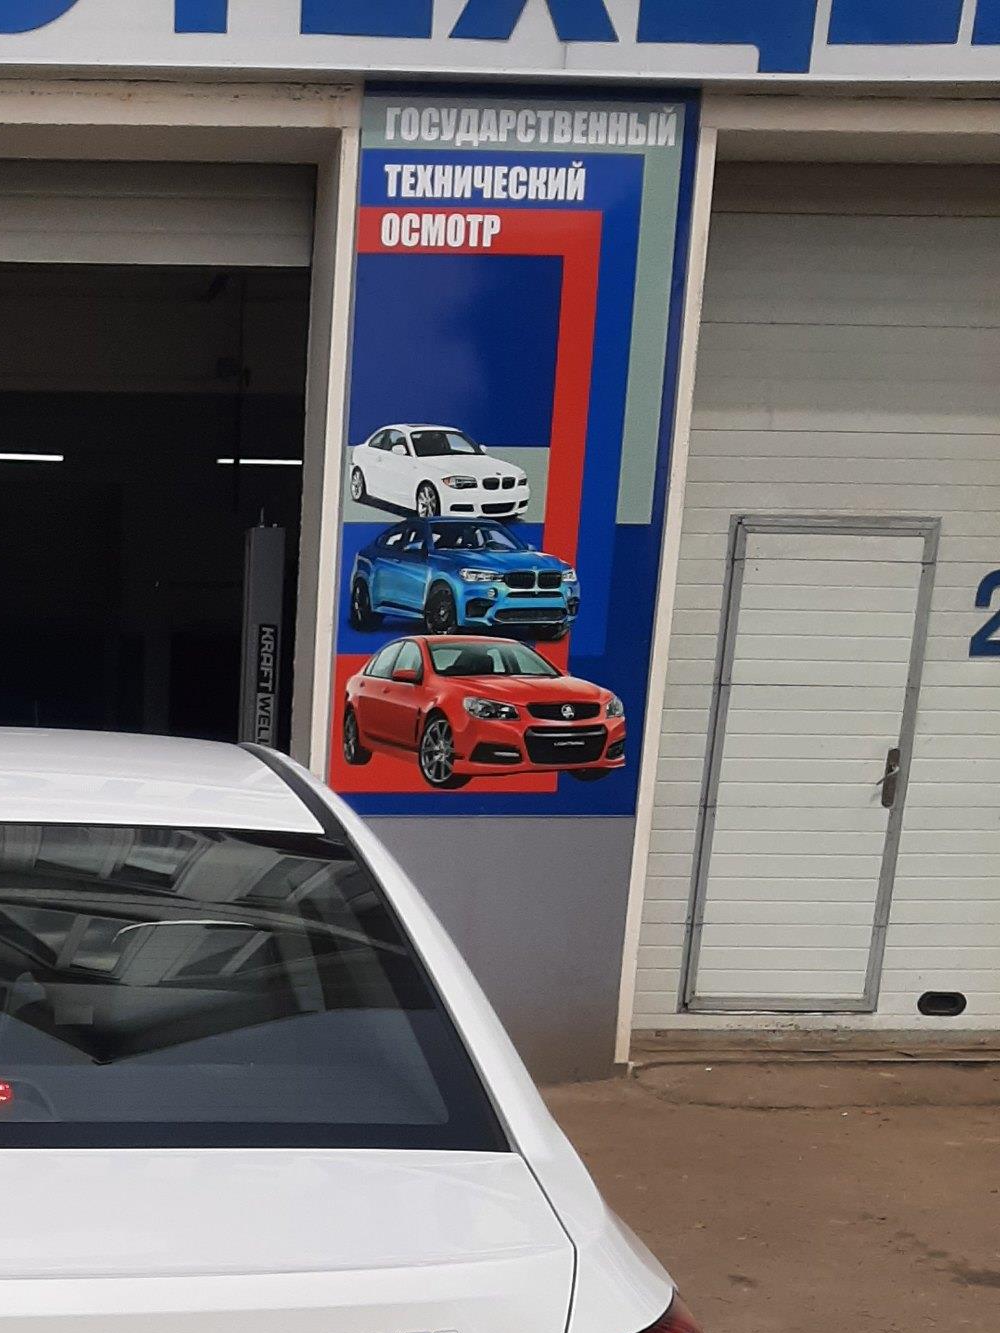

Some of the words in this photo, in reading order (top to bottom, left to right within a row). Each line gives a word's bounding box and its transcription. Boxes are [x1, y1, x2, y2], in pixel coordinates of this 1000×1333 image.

[385, 106, 677, 147] ГОСУДАРСТВЕННЫЙ
[384, 161, 586, 201] ТЕХНИЧЕСКИЙ
[380, 212, 501, 248] ОСМОТР
[259, 625, 275, 692] KRAFT
